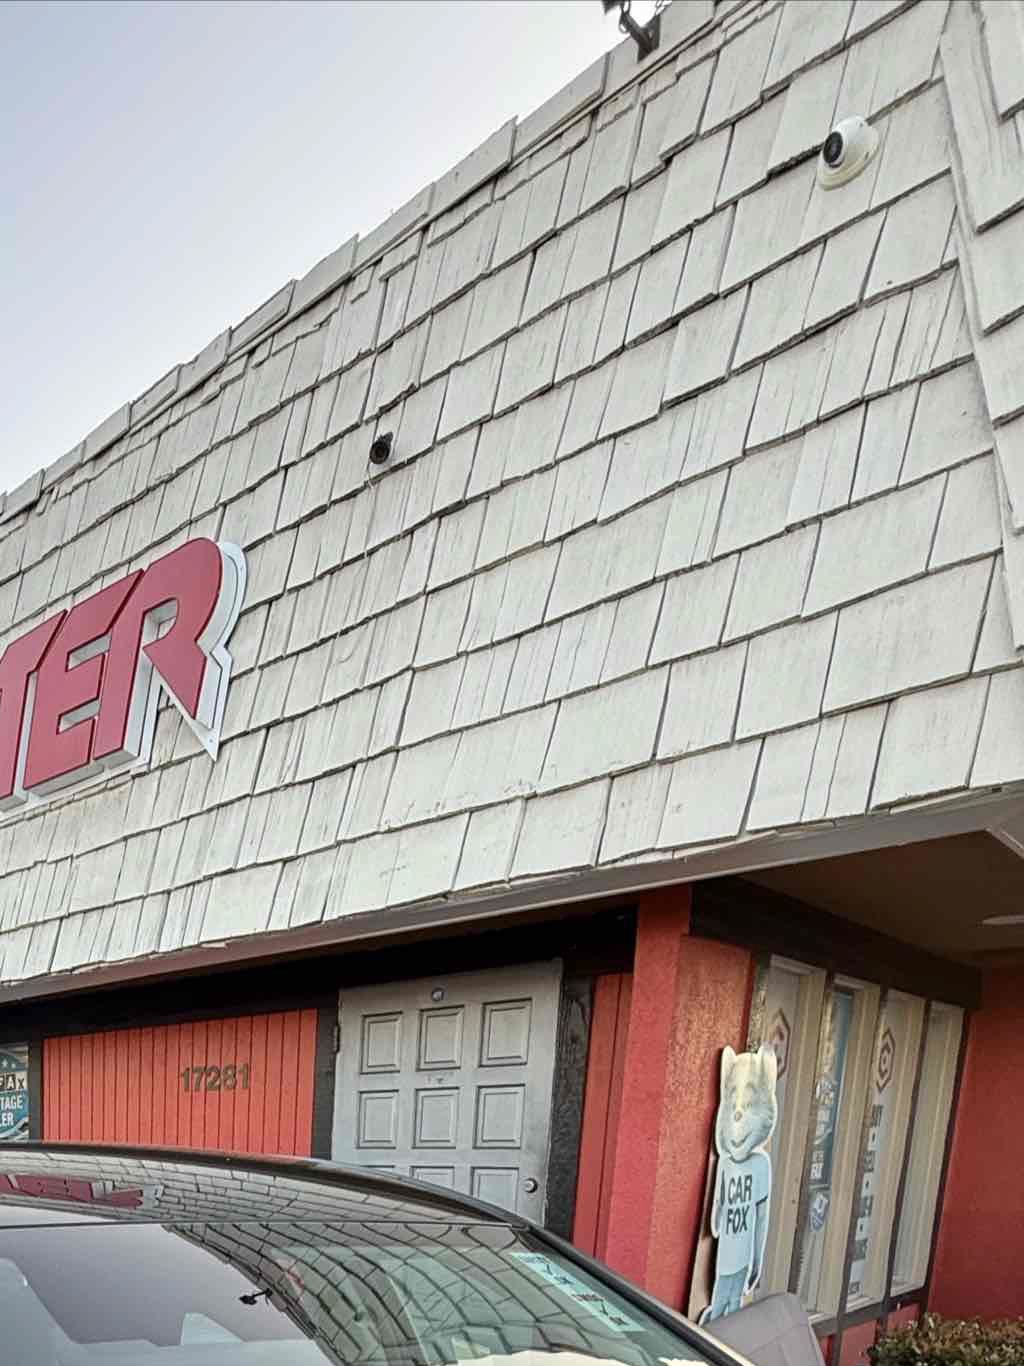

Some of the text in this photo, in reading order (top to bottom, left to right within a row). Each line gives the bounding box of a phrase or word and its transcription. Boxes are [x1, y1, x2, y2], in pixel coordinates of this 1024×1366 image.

[181, 1064, 250, 1092] 17281
[728, 1174, 753, 1205] CAR
[726, 1204, 750, 1235] FOX
